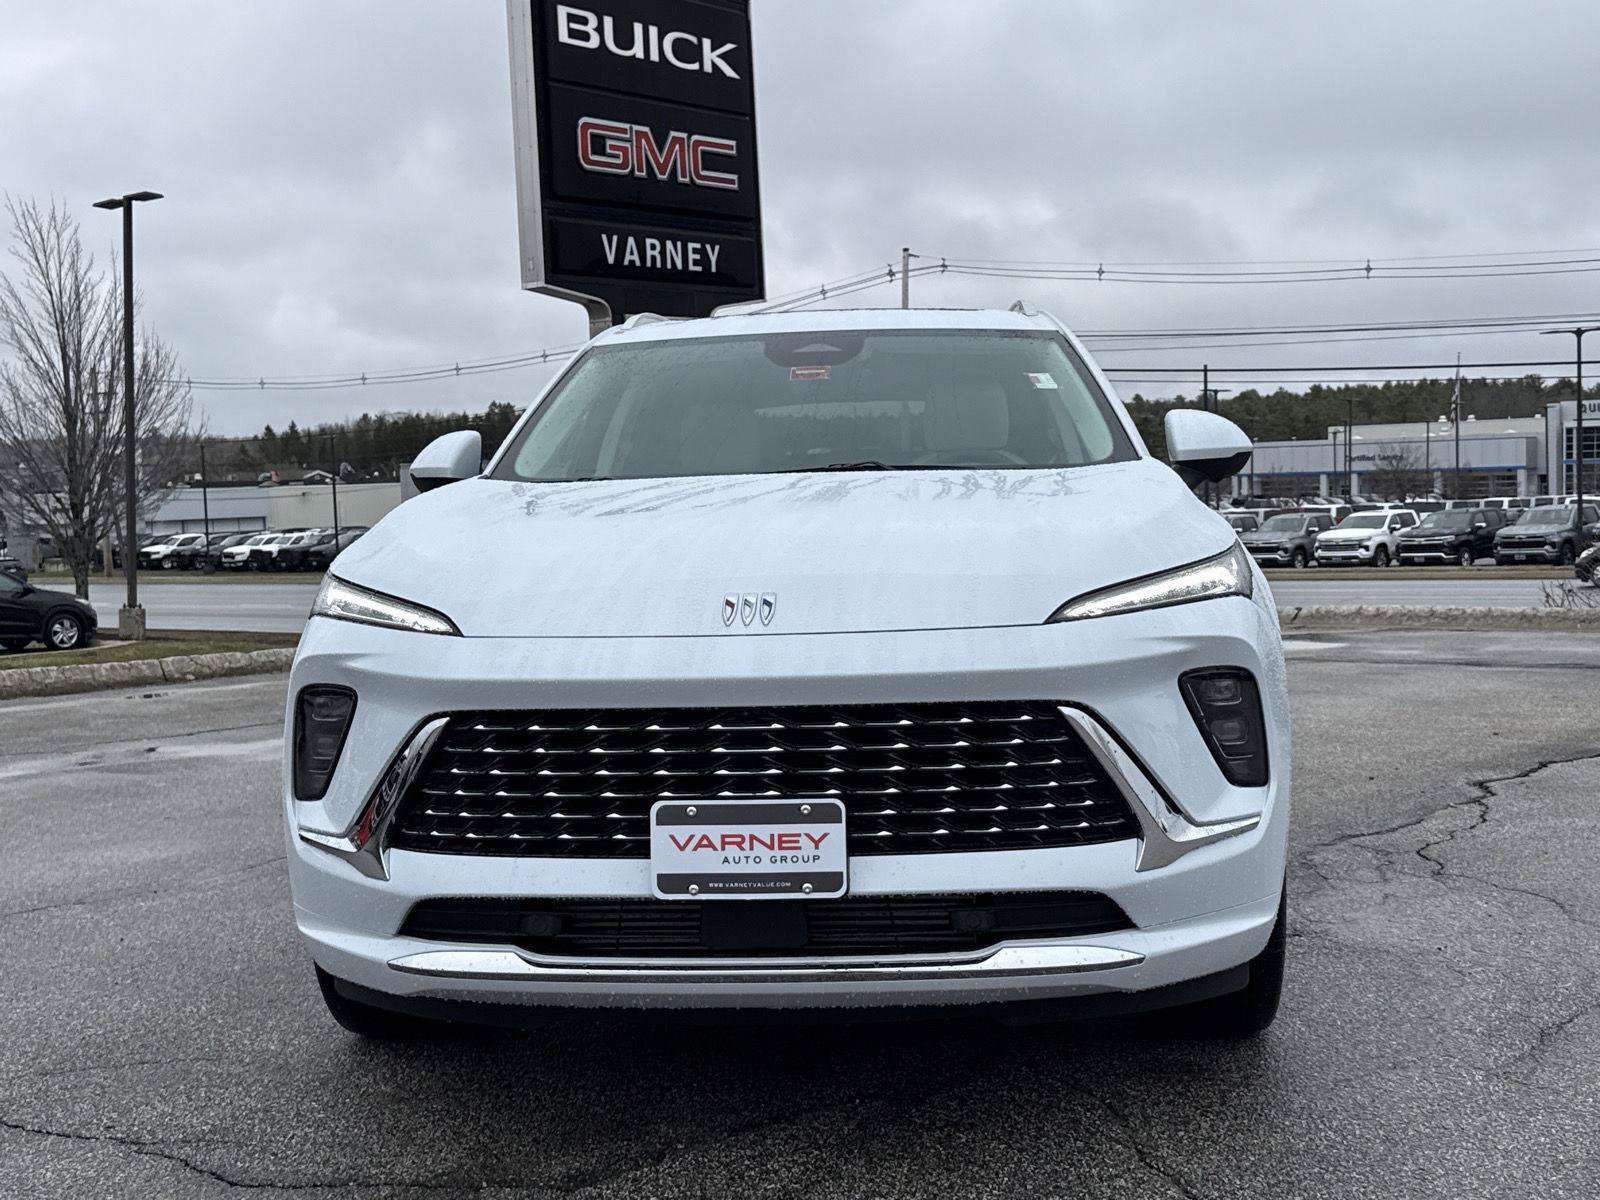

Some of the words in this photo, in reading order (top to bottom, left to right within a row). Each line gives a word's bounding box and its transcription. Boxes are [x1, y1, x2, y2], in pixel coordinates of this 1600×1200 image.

[556, 4, 741, 80] BUICK
[577, 116, 740, 191] GMC
[601, 233, 721, 273] VARNEY
[668, 832, 831, 852] VARNEY
[721, 855, 762, 865] AUTO
[769, 854, 821, 864] GROUP
